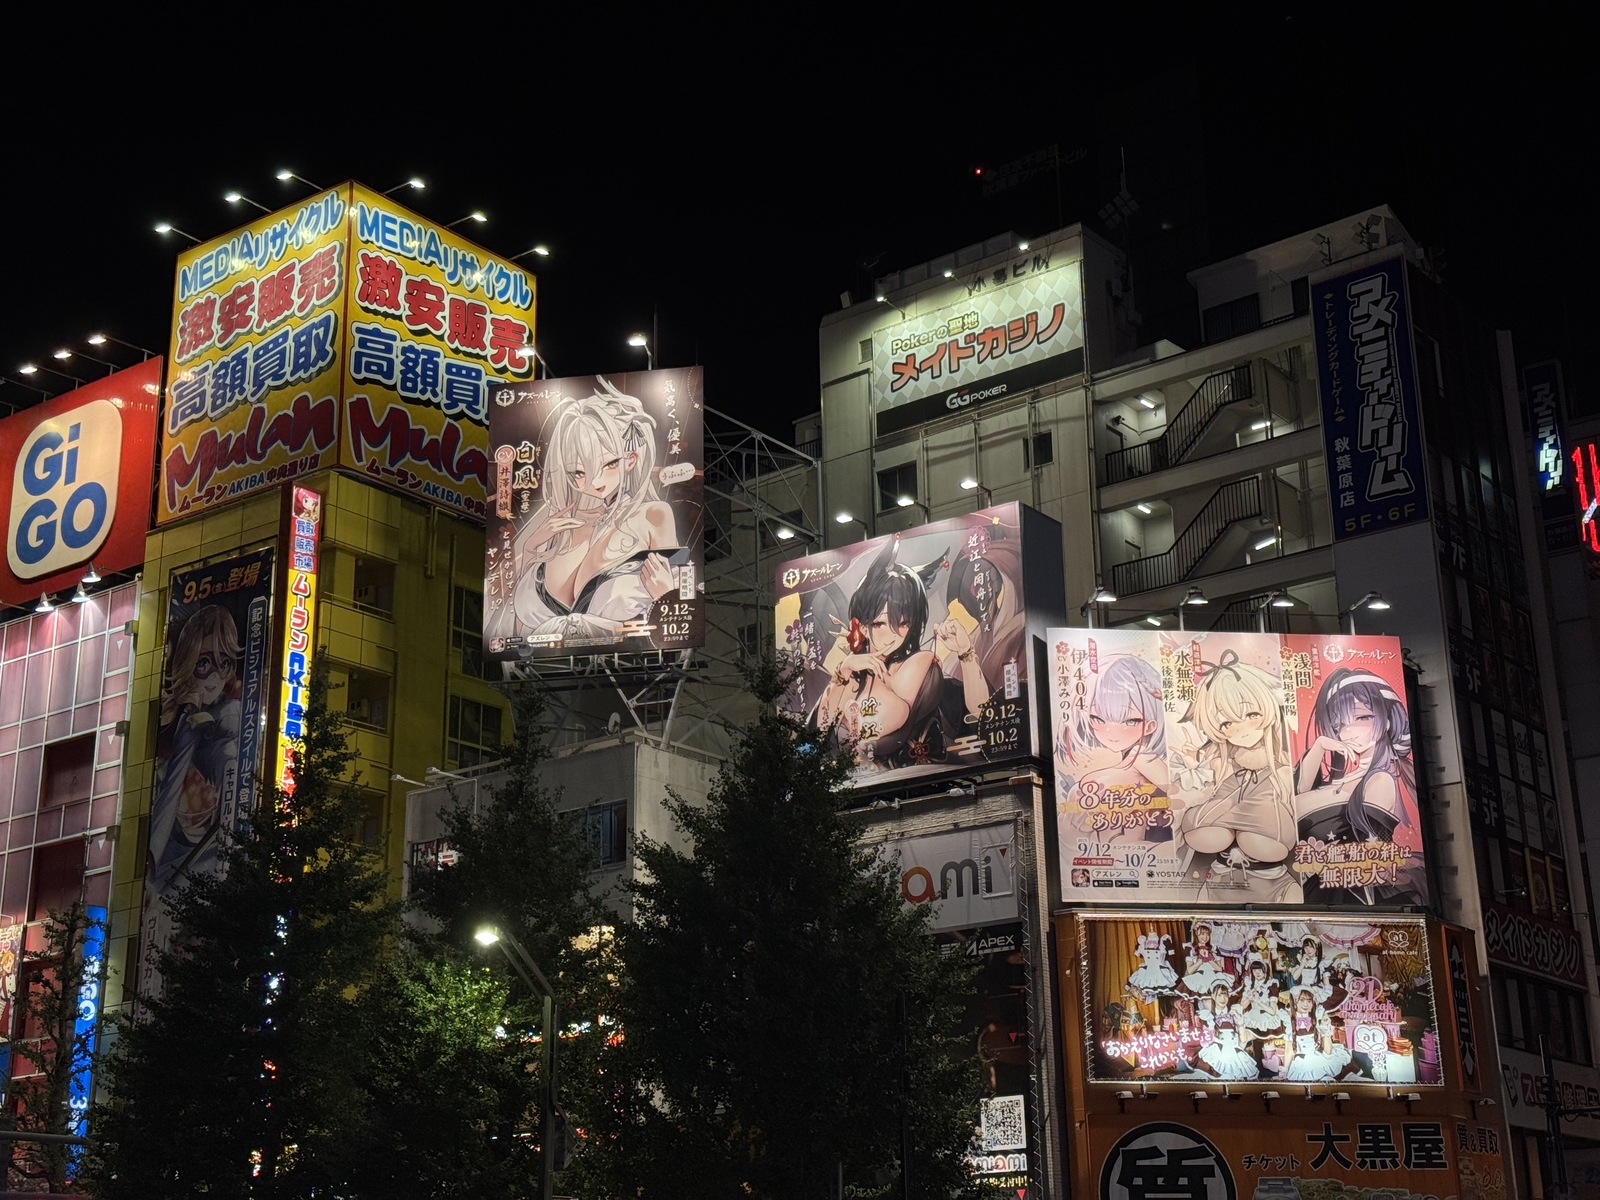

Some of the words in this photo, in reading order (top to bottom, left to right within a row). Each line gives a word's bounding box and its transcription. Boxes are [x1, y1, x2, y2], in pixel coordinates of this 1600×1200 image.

[179, 191, 343, 304] MEDIAリサイクル
[357, 204, 532, 309] MEDIAリサイクル
[176, 242, 341, 361] 激安販売
[357, 250, 530, 373] 激安販売
[890, 302, 1065, 392] メイドカジノ
[891, 312, 979, 354] Pokerの聖地
[169, 312, 337, 436] 高額買取
[351, 325, 491, 425] 高額買
[165, 393, 338, 515] Mulan
[348, 397, 489, 483] Mula
[1334, 437, 1356, 509] 秋葉原店
[295, 519, 315, 537] 買取
[661, 622, 690, 636] 10.2
[1293, 653, 1313, 688] 浅間
[1346, 648, 1397, 661] アズールレーン
[1175, 650, 1196, 702] 水無瀬
[988, 727, 1018, 746] 10.2
[1079, 780, 1153, 810] 8年分の
[1092, 809, 1175, 832] ありがとう
[1077, 842, 1112, 858] 9/12
[1095, 870, 1123, 878] アズレン
[978, 934, 1015, 949] APEX
[1484, 908, 1580, 979] メイドカジノ
[1352, 980, 1376, 1001] 21
[1140, 1048, 1193, 1069] これからも。
[1242, 1153, 1301, 1172] チケット
[1305, 1122, 1449, 1171] 大黒屋
